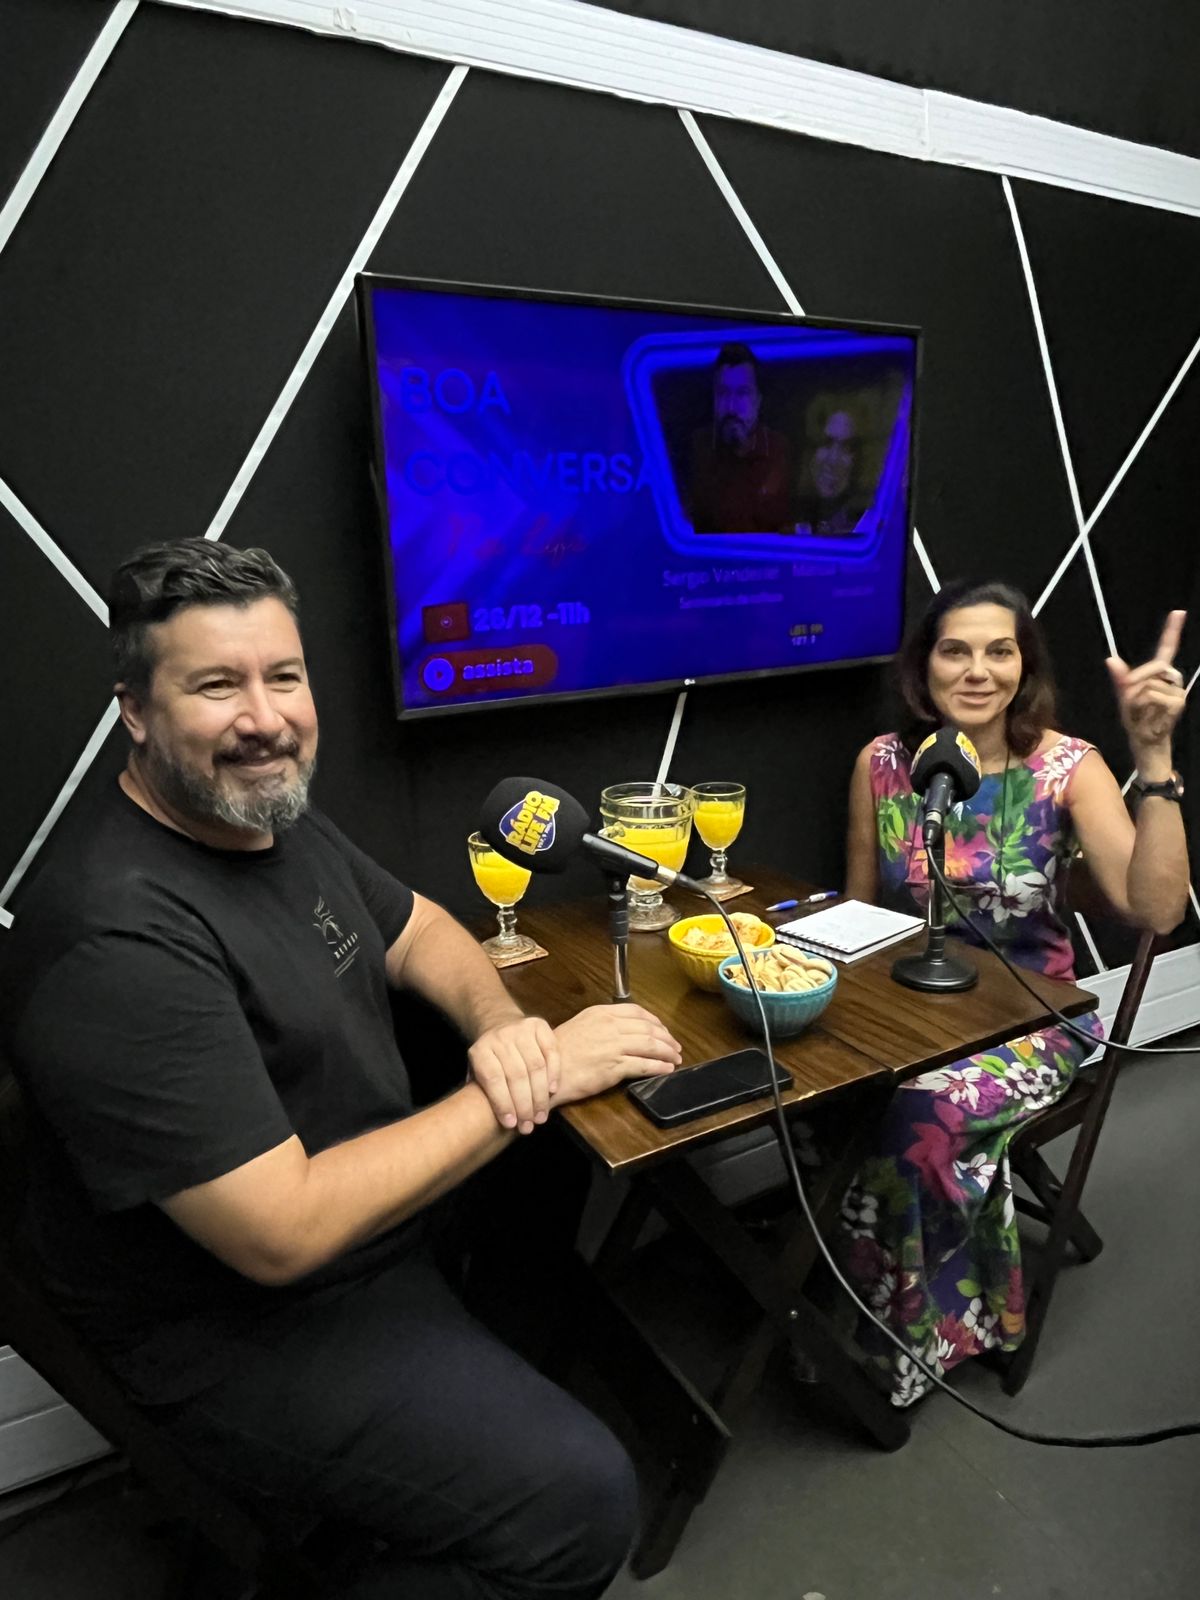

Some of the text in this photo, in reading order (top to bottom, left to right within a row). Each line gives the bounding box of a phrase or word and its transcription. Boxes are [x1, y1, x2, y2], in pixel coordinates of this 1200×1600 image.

[400, 366, 511, 416] BOA
[473, 604, 543, 632] 26/12
[462, 658, 534, 681] assista
[519, 819, 547, 856] LIFE
